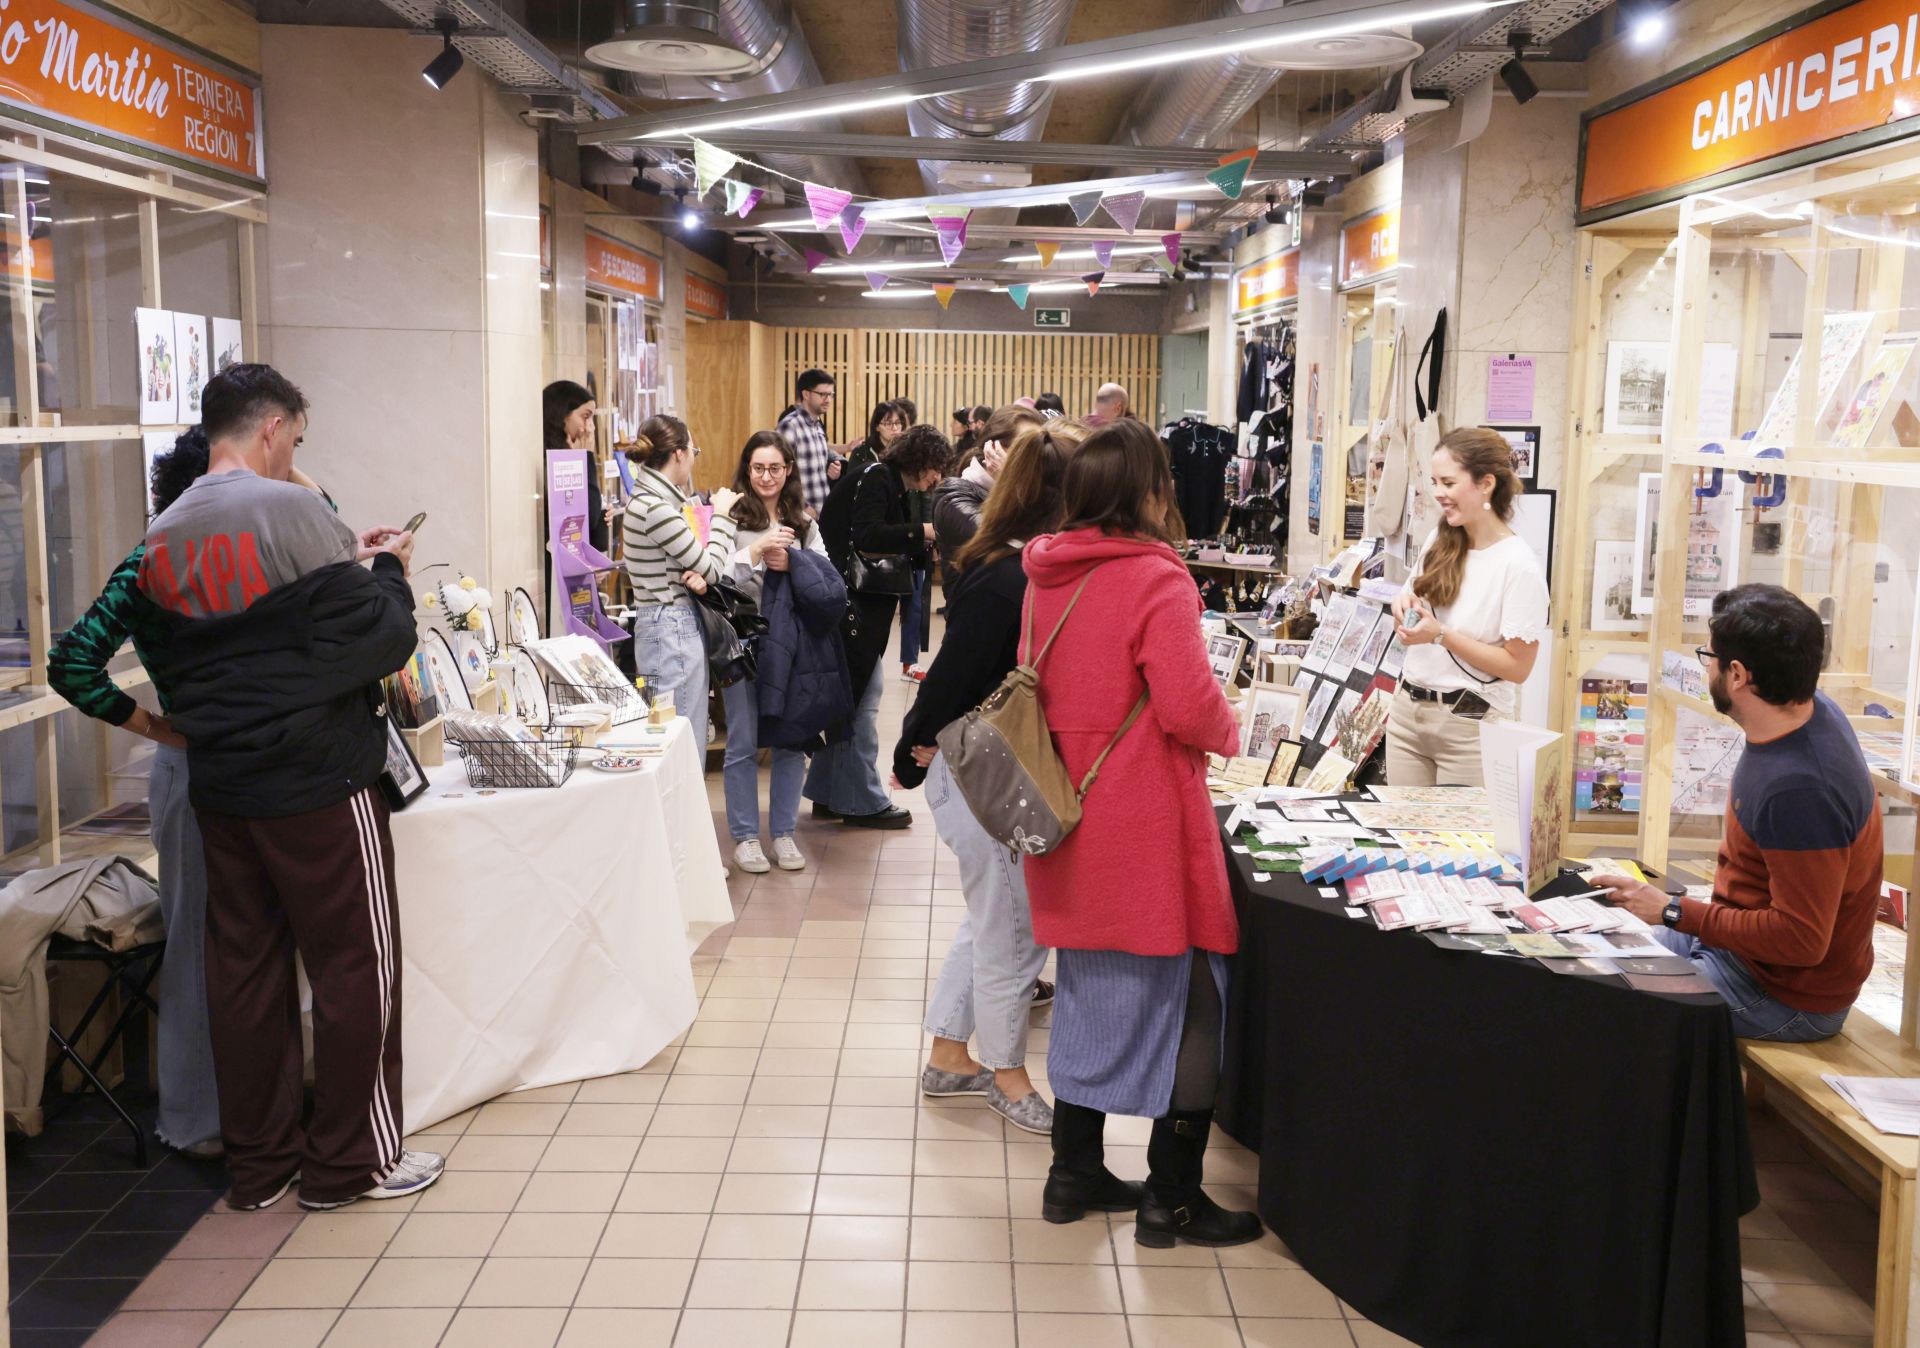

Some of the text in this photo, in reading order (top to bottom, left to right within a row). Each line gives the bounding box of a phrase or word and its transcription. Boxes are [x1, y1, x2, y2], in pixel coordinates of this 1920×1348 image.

[172, 63, 245, 121] TERNERA
[1691, 13, 1920, 151] CARNICERI
[202, 107, 221, 123] DE LA
[245, 131, 254, 167] 7
